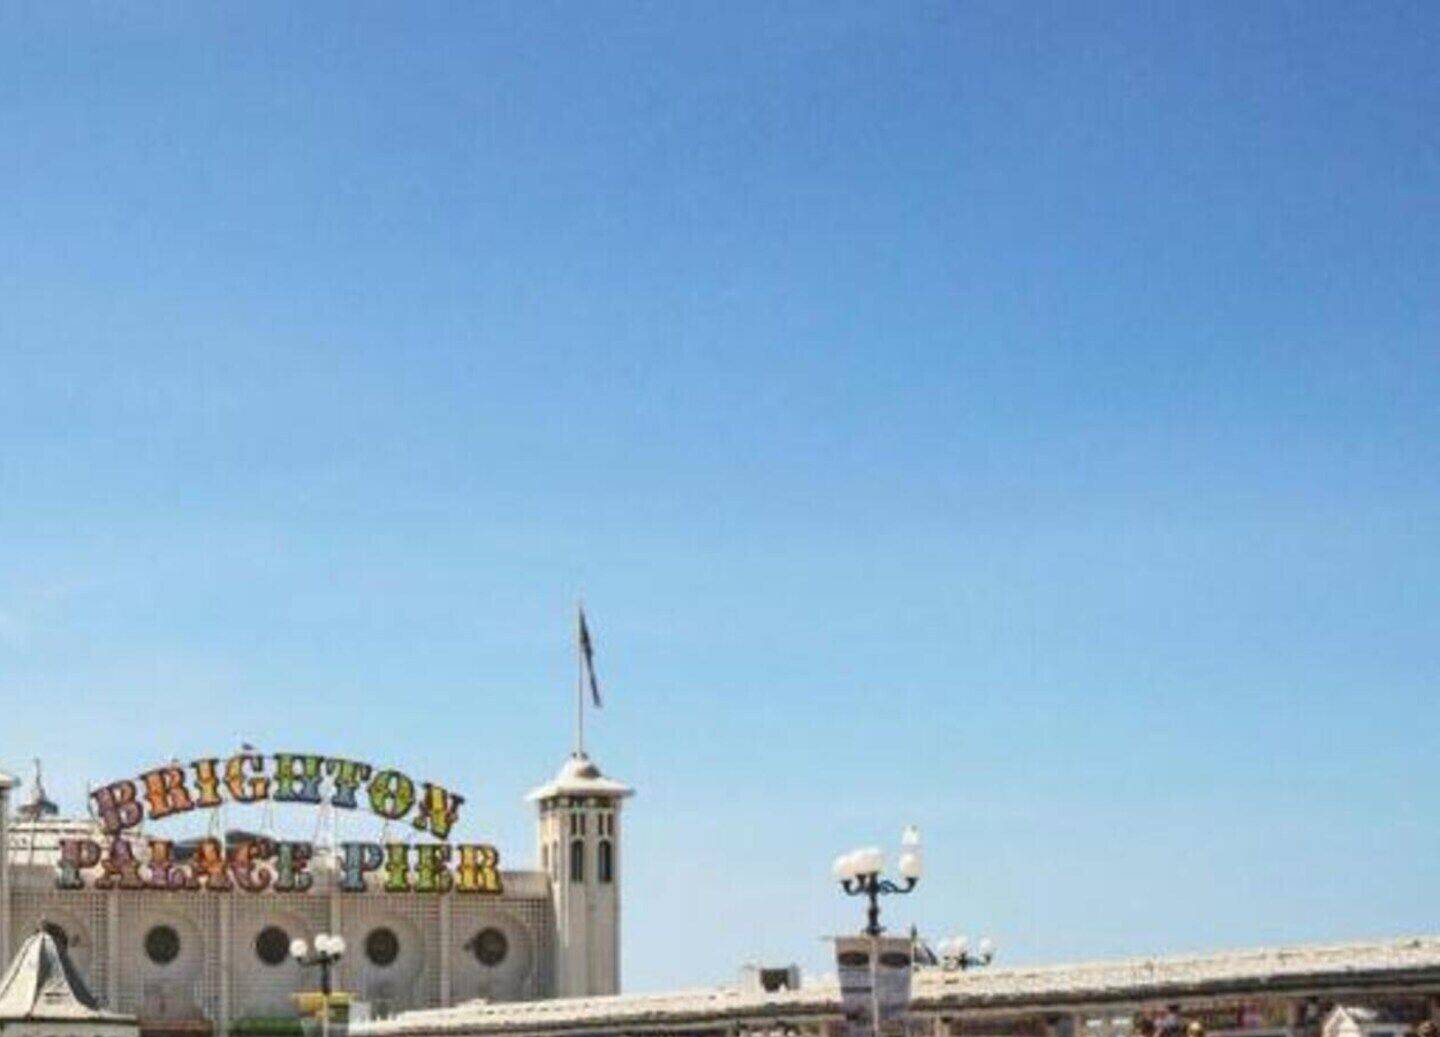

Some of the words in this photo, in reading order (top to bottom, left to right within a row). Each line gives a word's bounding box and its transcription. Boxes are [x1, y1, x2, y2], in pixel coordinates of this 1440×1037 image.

[90, 752, 465, 839] BRIGHTON
[59, 838, 313, 892] PALACE
[341, 841, 505, 893] PIER
